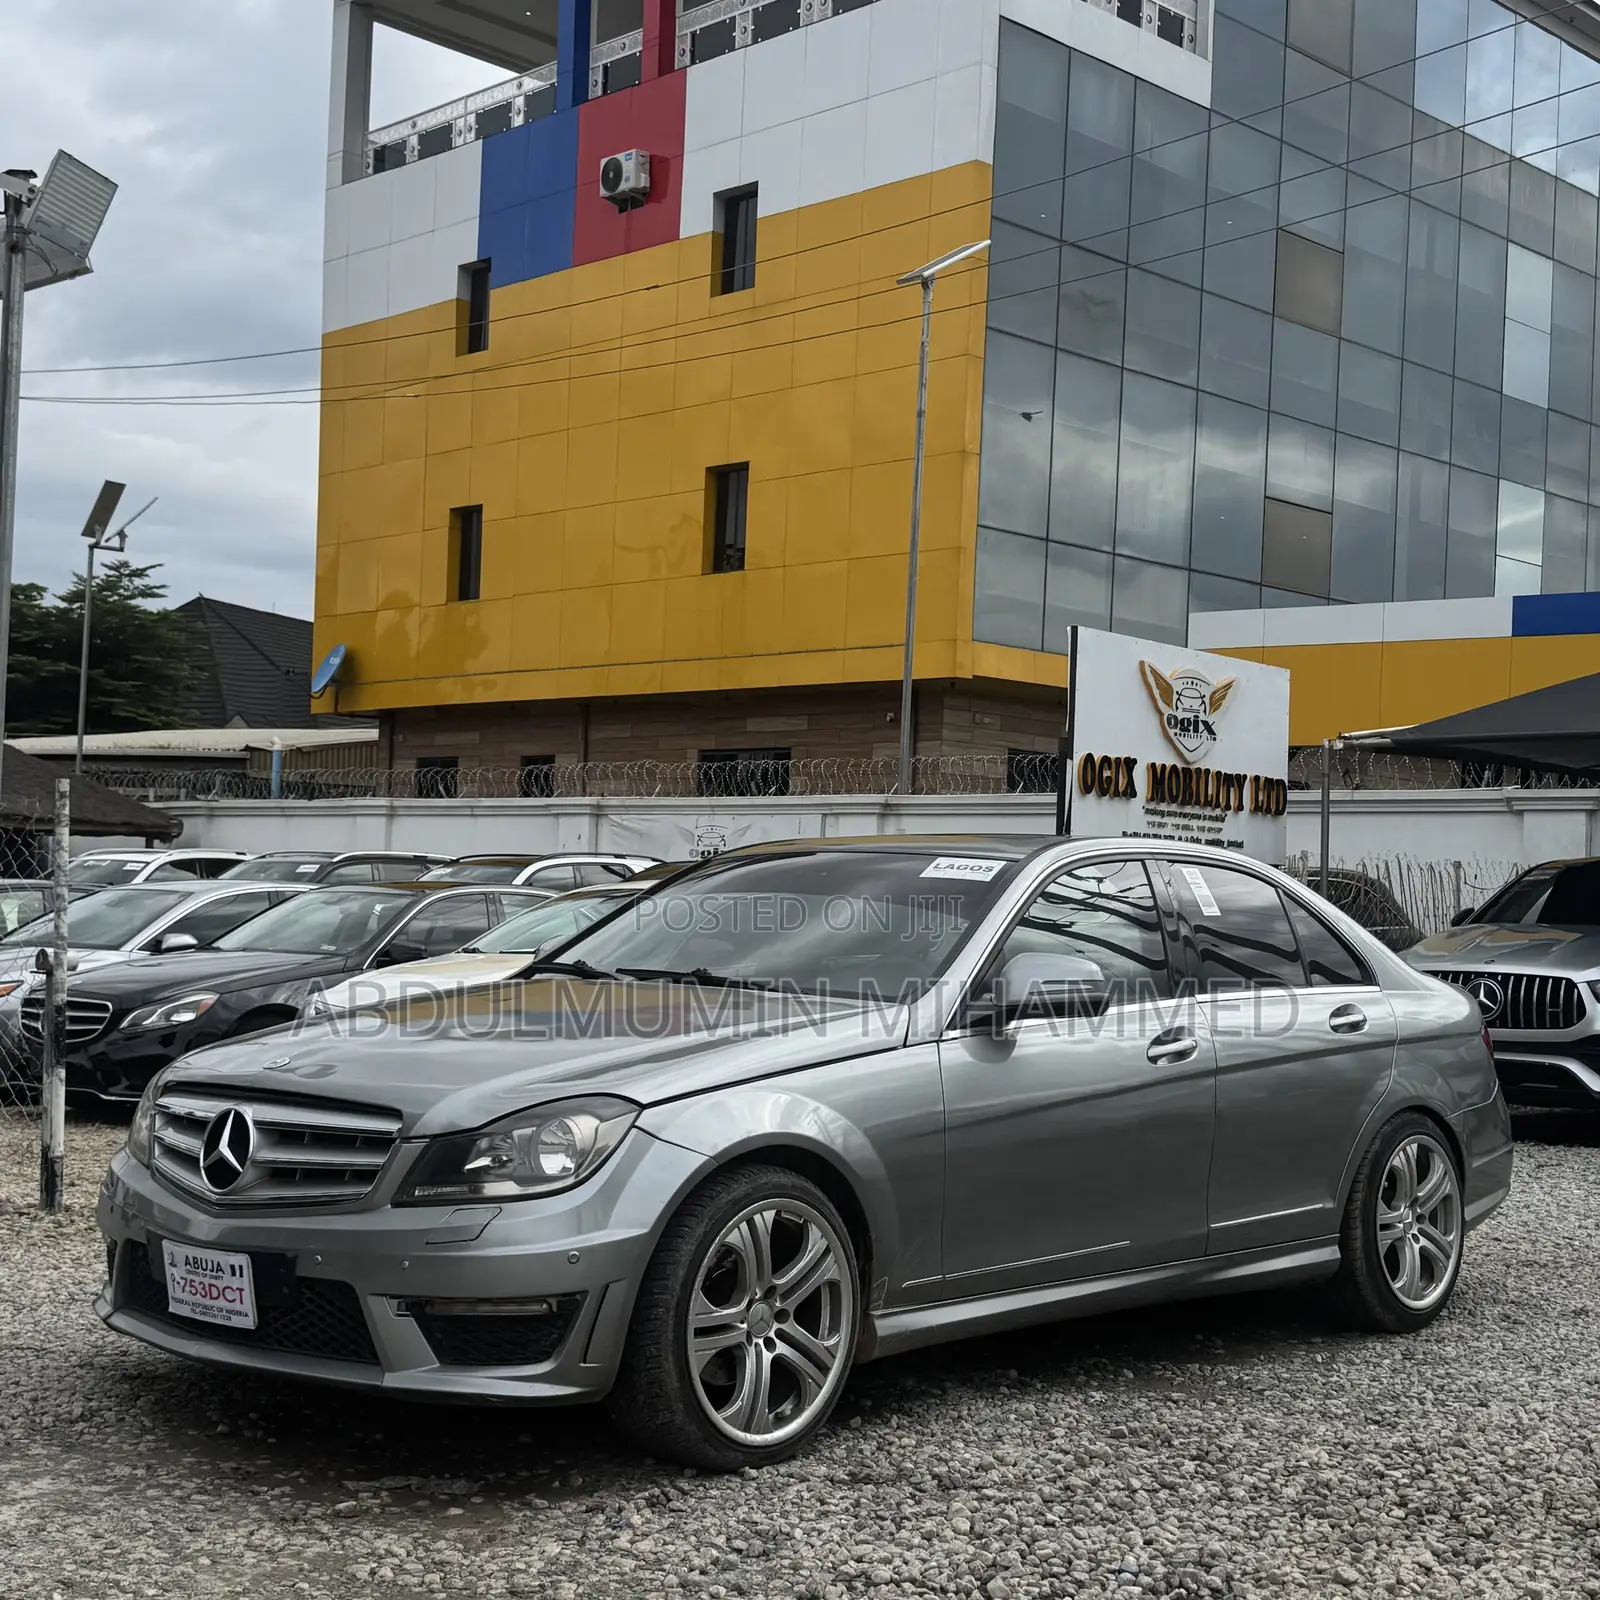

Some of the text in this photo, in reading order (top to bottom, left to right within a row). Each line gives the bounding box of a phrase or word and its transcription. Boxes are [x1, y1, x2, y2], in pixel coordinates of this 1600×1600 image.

[1078, 752, 1287, 816] OGIX MOBILITY LTD
[932, 863, 995, 873] LAGOS
[184, 1254, 226, 1275] ABUJA
[191, 1300, 216, 1312] REPUBLIC
[225, 1308, 249, 1318] NIGERIA
